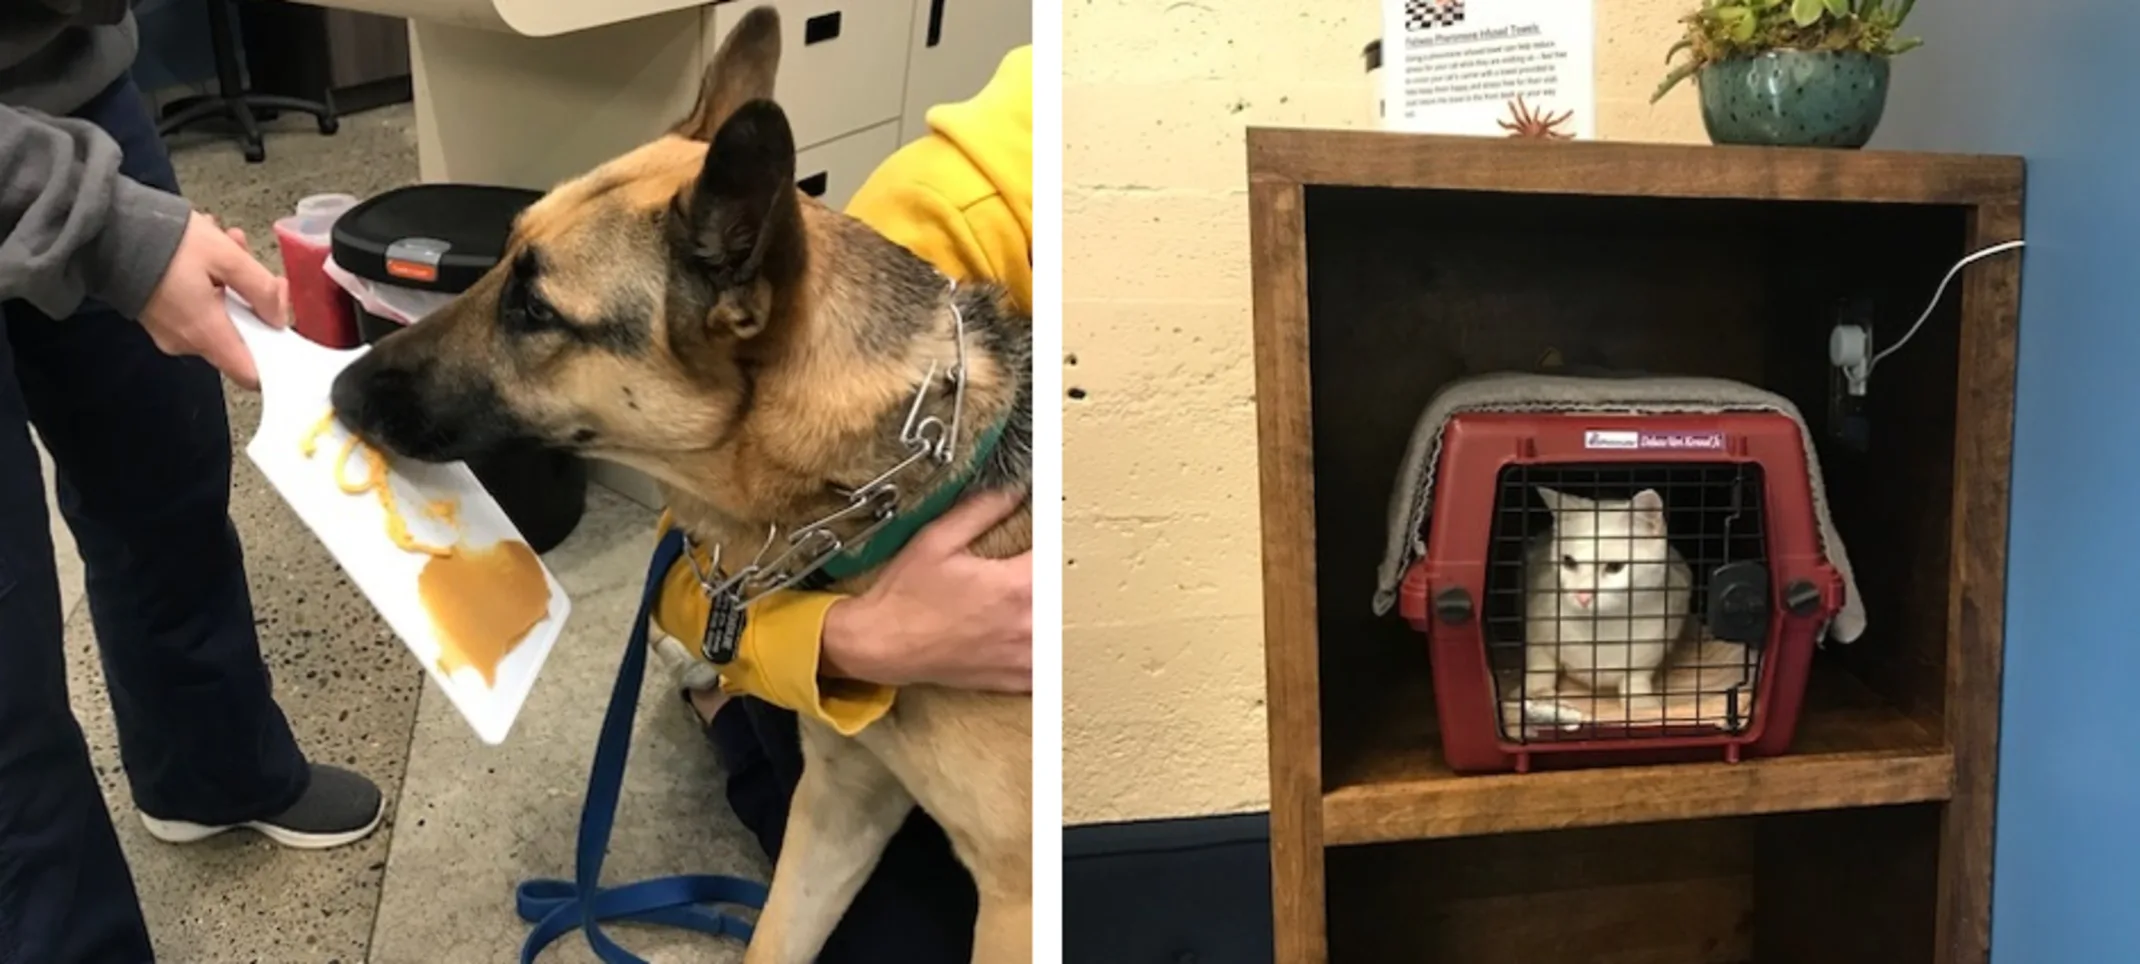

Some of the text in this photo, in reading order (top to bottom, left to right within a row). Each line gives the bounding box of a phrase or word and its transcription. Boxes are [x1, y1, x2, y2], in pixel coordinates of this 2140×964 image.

[1480, 27, 1508, 41] Infused
[1518, 42, 1531, 50] help
[1434, 63, 1447, 71] your
[1481, 69, 1493, 77] with
